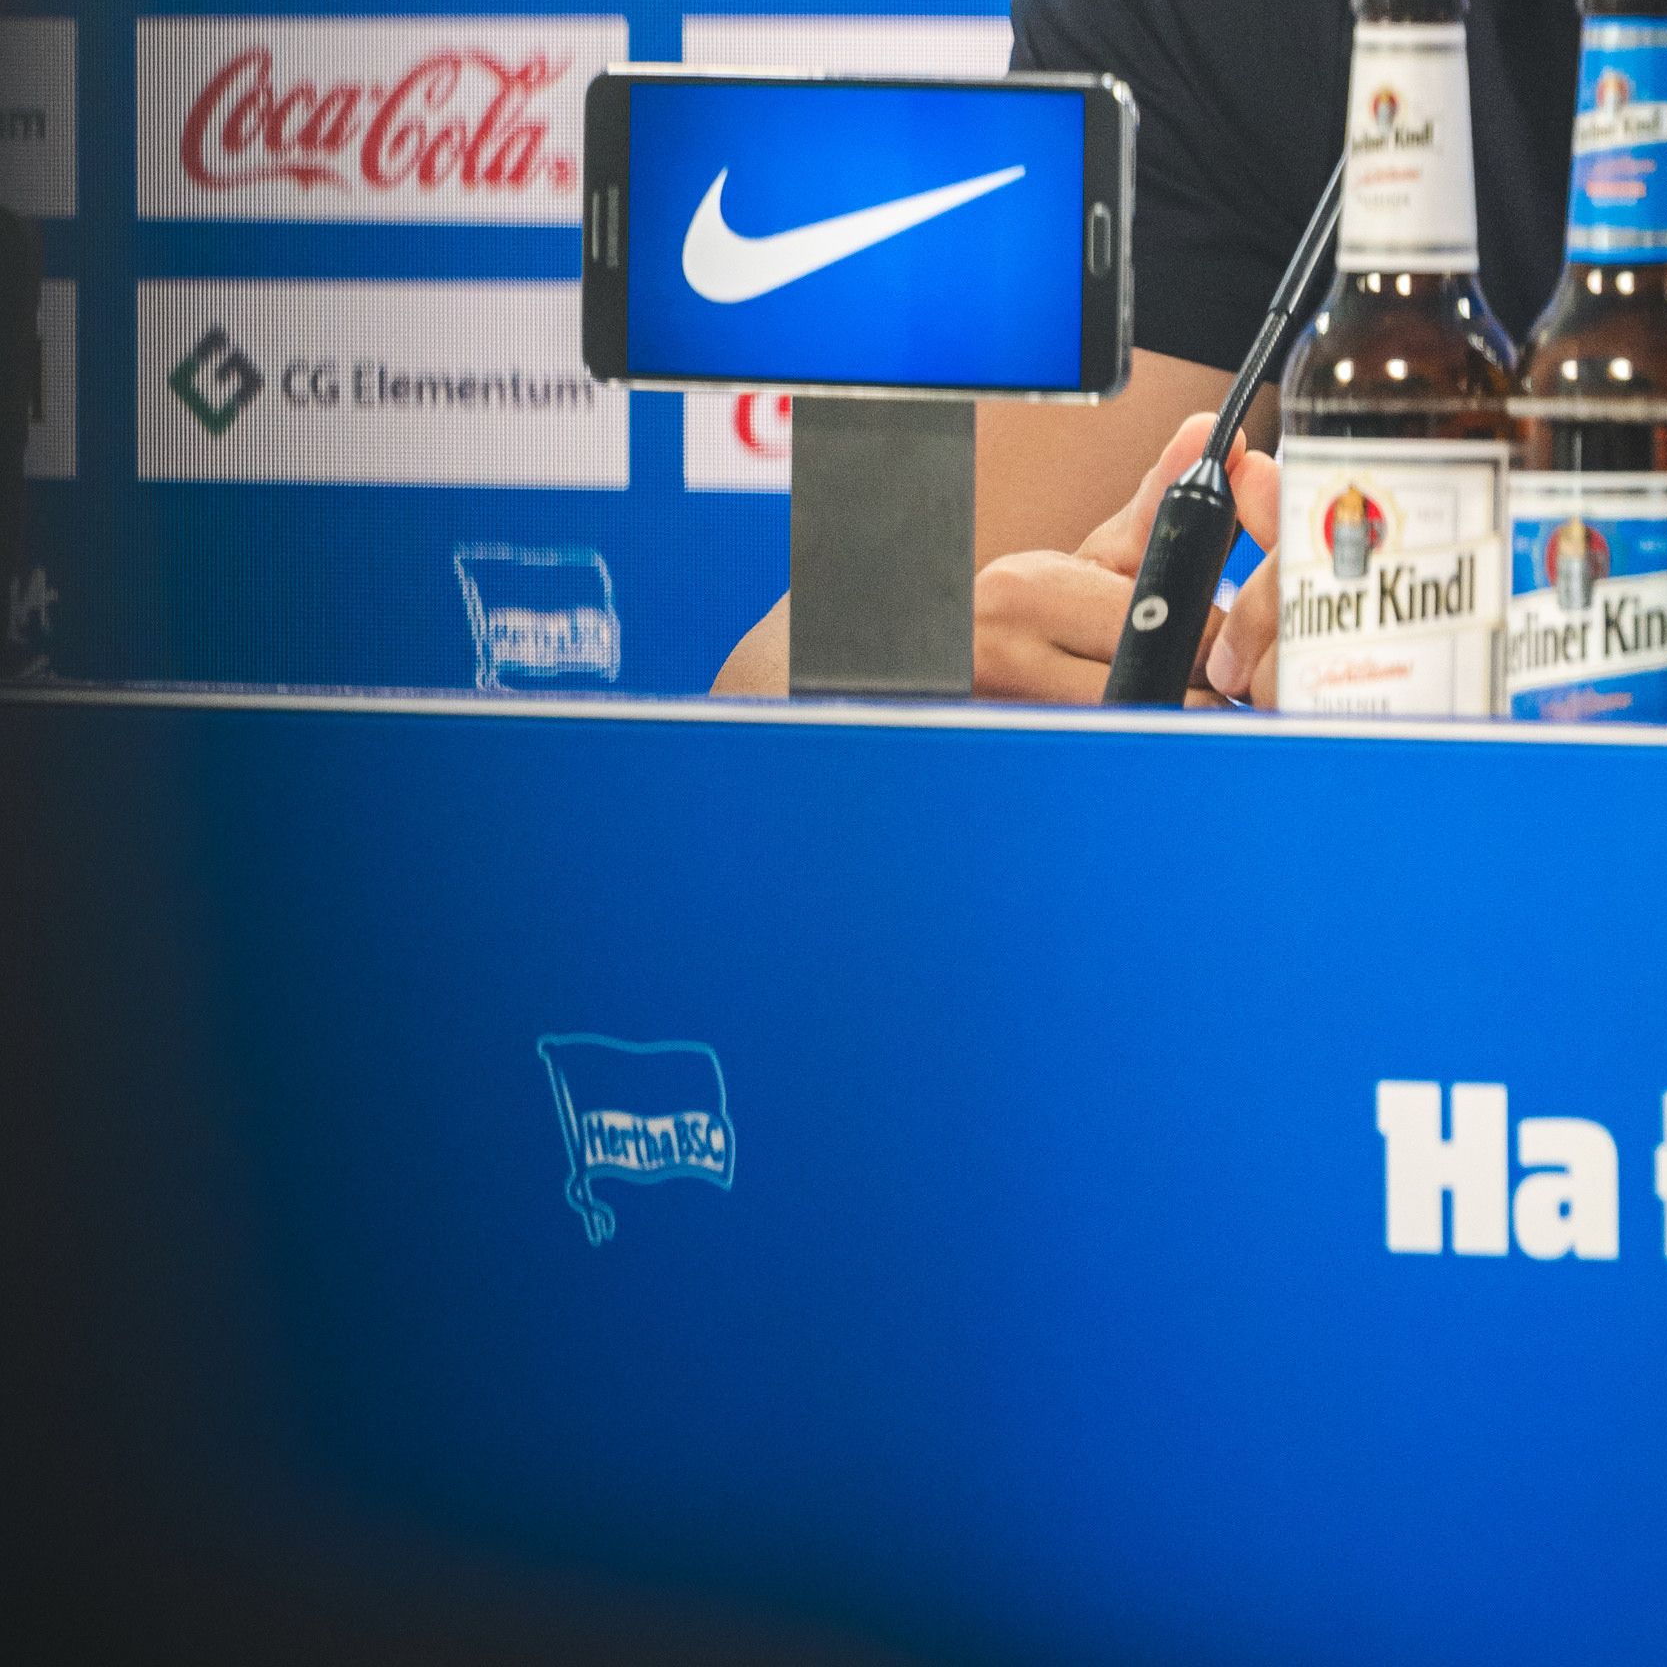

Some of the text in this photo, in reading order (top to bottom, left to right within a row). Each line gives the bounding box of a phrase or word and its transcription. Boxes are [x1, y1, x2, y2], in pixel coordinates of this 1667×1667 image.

[179, 48, 576, 192] Coca-Cola
[281, 353, 600, 407] CG Elementum
[1281, 554, 1477, 644] erliner Kindl
[1508, 611, 1593, 675] erliner
[584, 1112, 726, 1166] Hertha BSC
[1376, 1079, 1620, 1261] Ha
